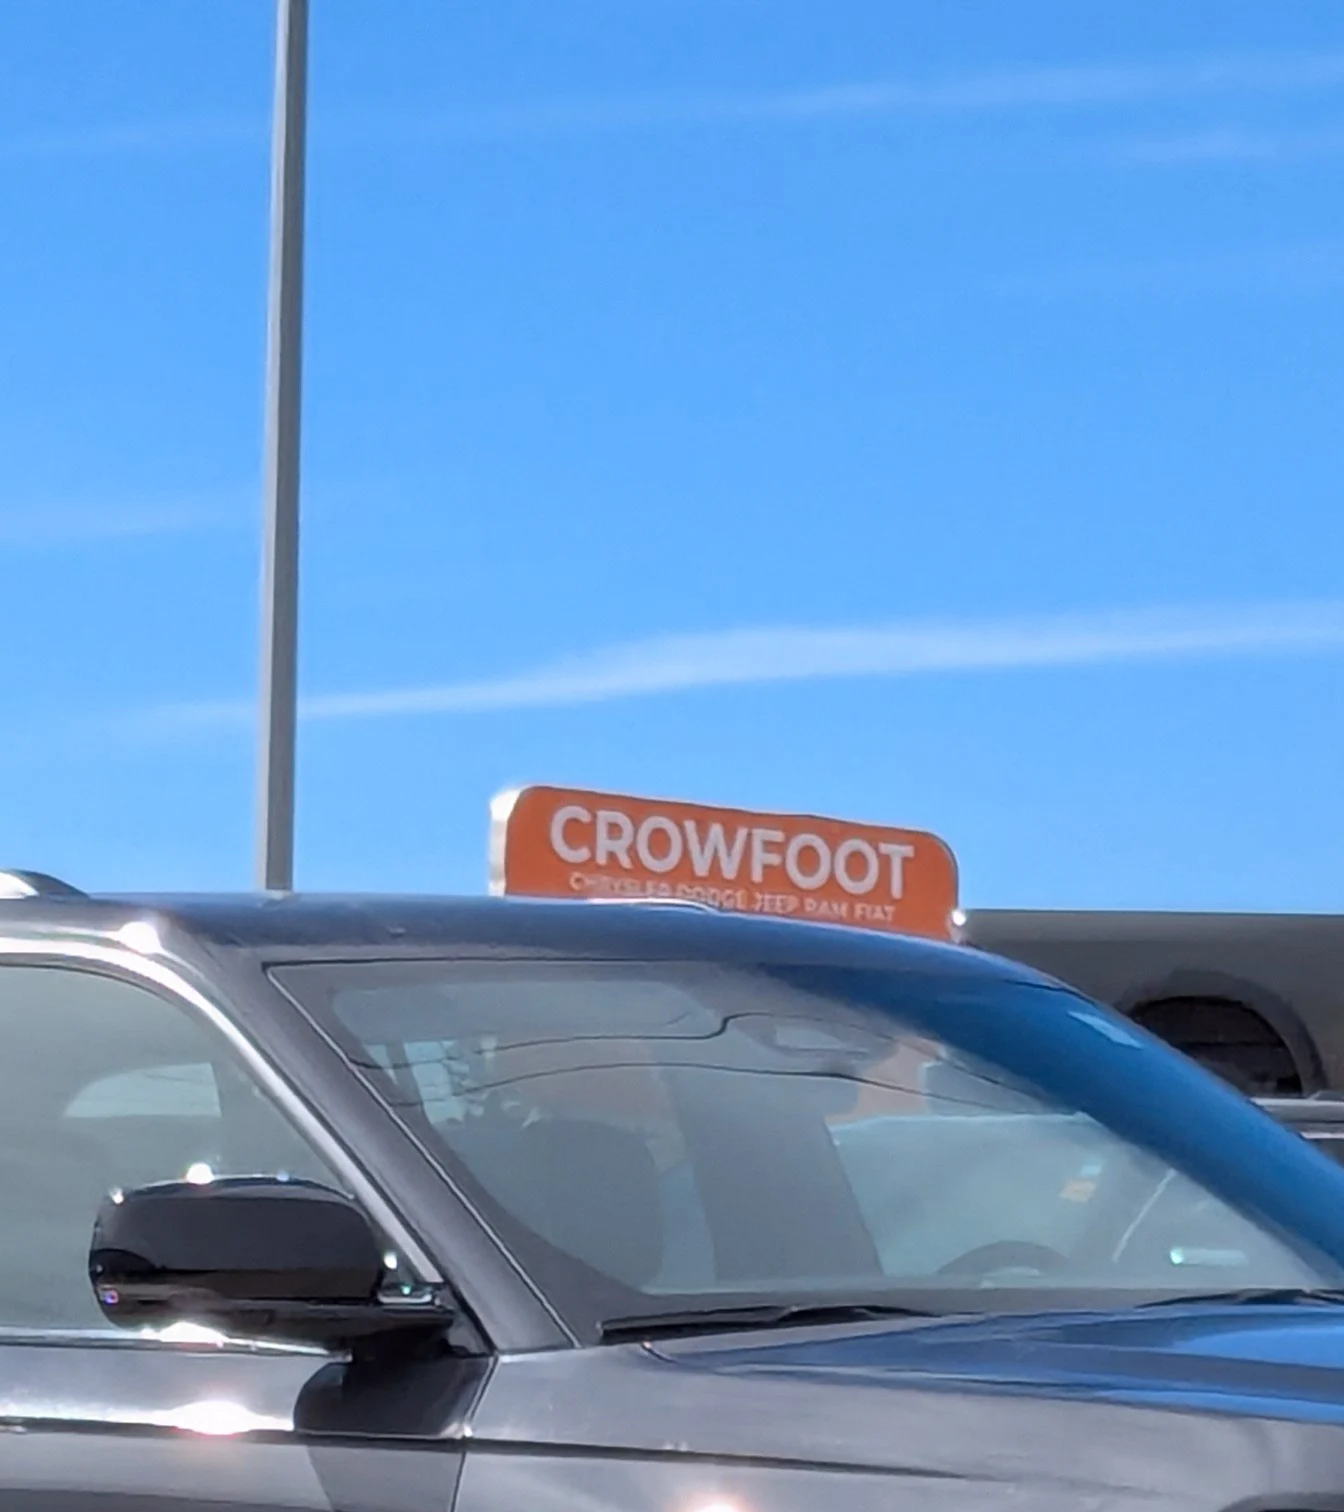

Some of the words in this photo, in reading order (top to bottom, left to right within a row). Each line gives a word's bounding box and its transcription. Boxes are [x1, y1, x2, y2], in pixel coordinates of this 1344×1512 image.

[550, 804, 915, 899] CROWFOOT
[751, 891, 800, 915] JEEP
[803, 896, 848, 919] RAM
[854, 901, 896, 922] FIAT
